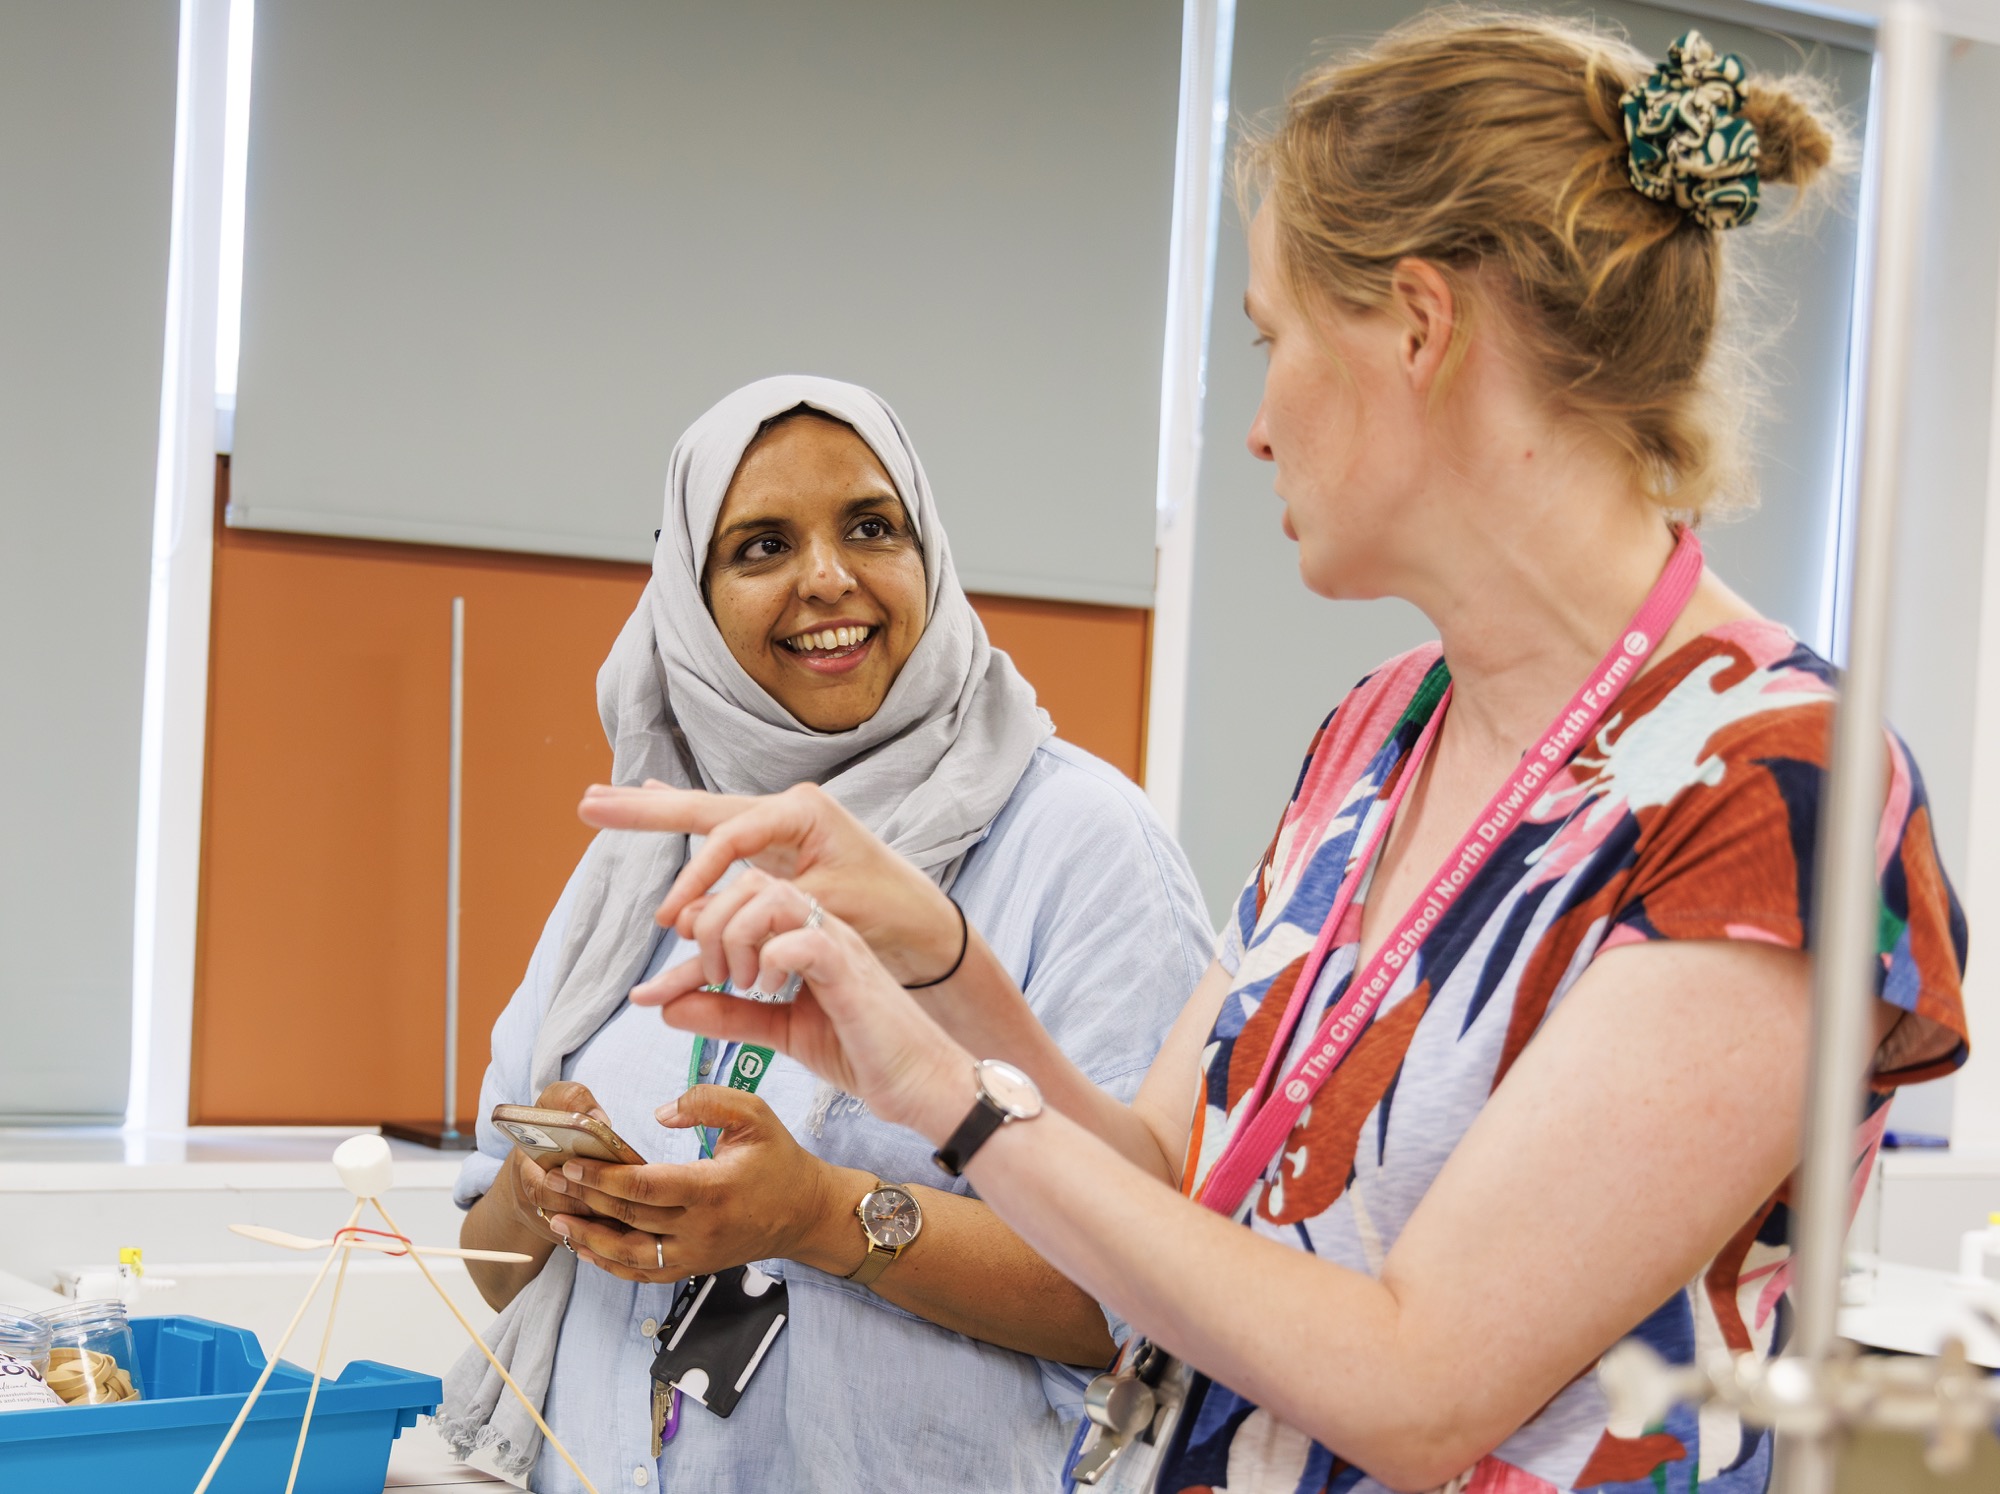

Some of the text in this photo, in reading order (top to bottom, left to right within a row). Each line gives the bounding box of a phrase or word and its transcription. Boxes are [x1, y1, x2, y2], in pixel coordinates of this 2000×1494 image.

[1300, 654, 1632, 1079] The Charter School North Dulwich Sixth Form
